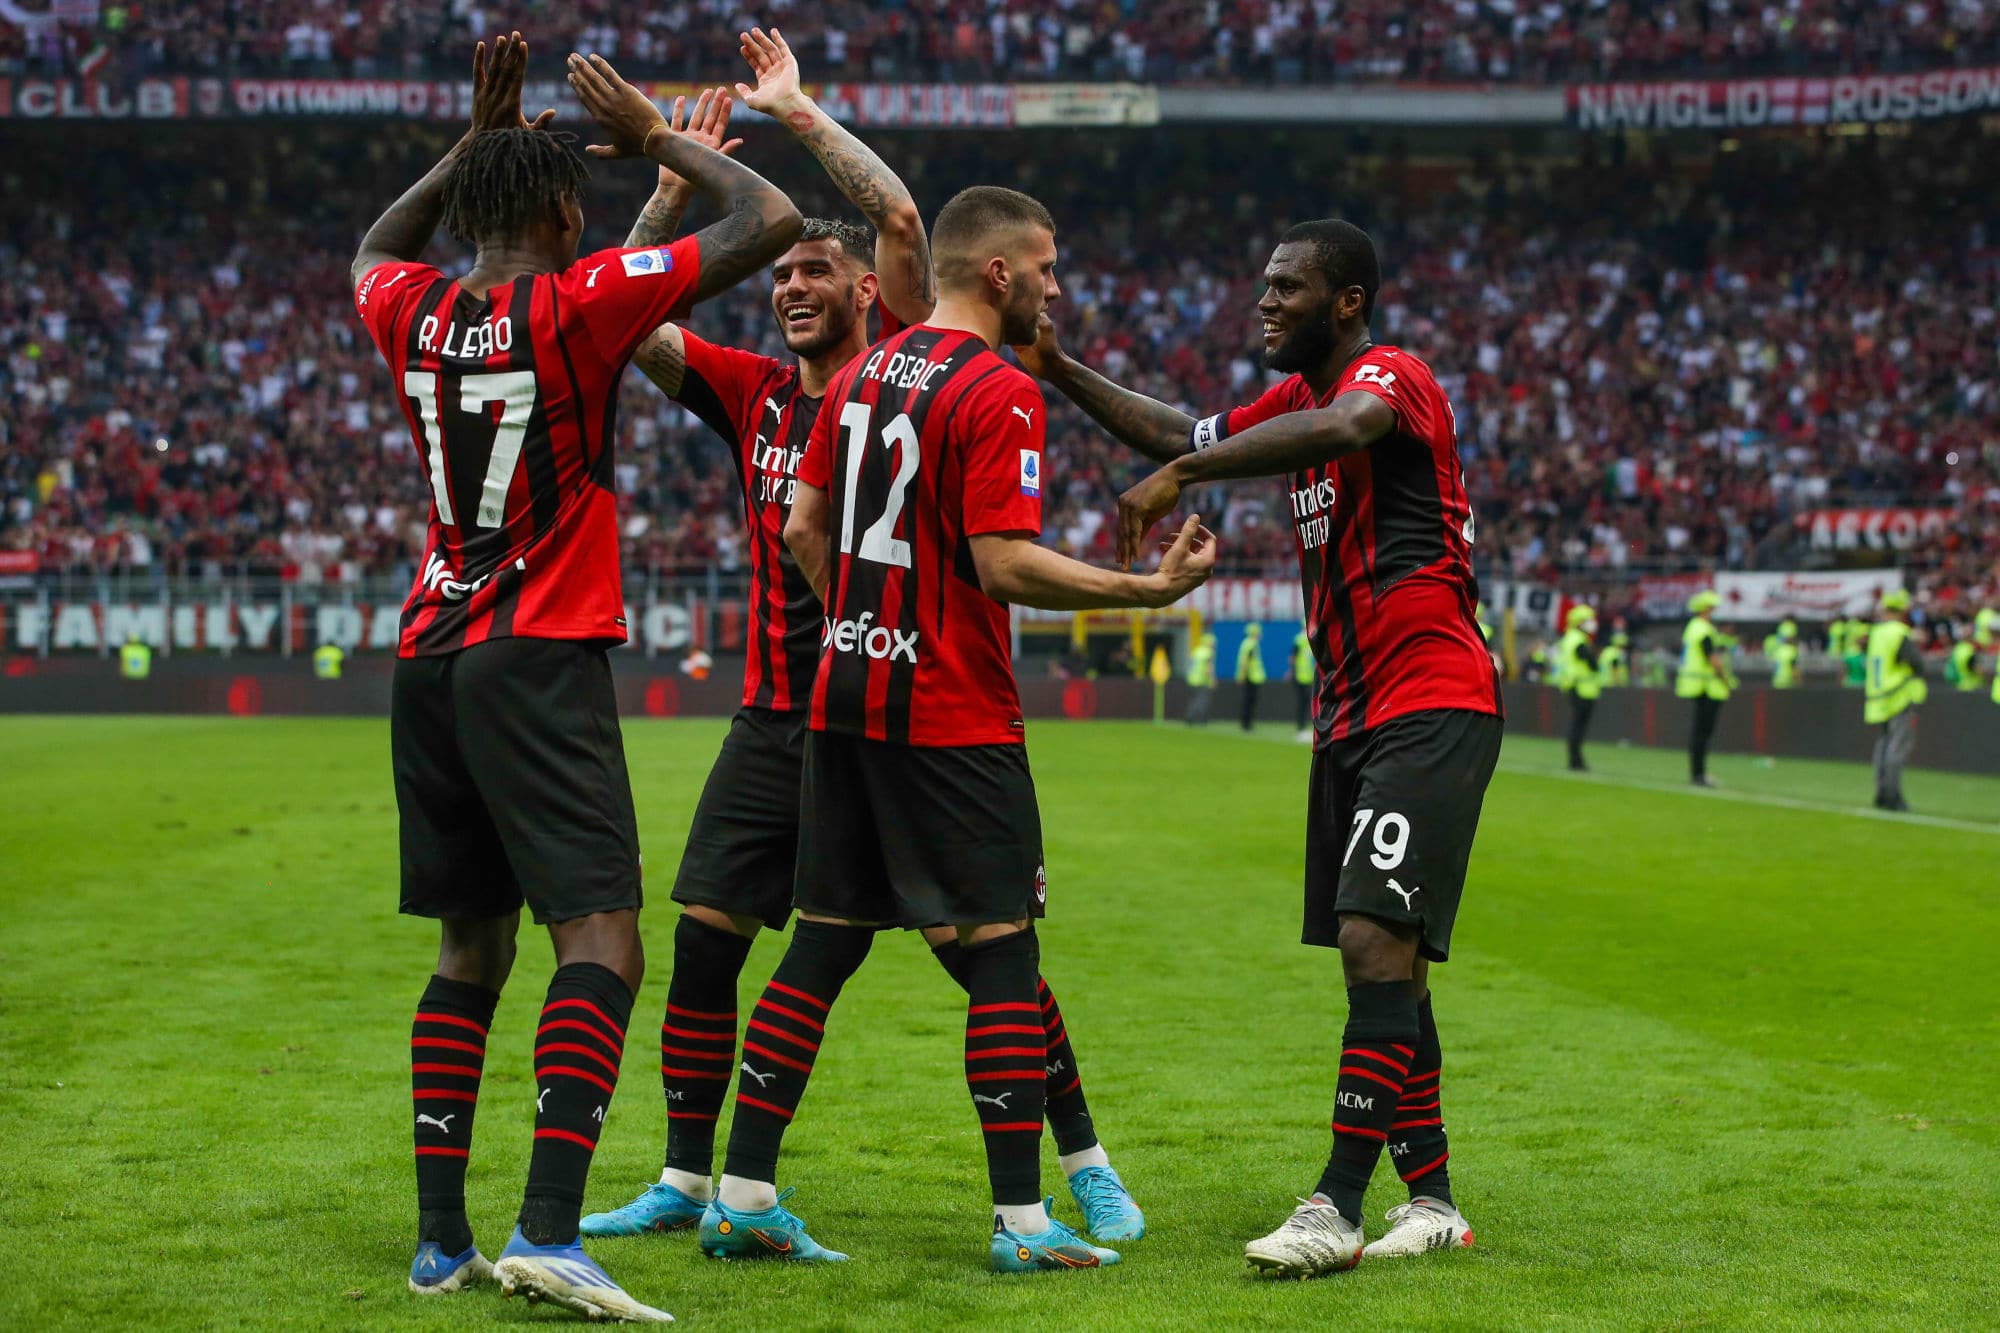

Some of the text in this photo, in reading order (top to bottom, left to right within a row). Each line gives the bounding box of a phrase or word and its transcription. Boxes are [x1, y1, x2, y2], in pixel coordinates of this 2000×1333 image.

[18, 82, 176, 118] CLUB
[1578, 80, 1771, 127] NAVIGLIO
[404, 370, 537, 528] 17
[839, 401, 921, 569] 12
[1300, 515, 1329, 550] BETTER
[16, 604, 279, 648] FAMILY
[1342, 809, 1411, 871] 79
[1336, 1090, 1375, 1111] ACM
